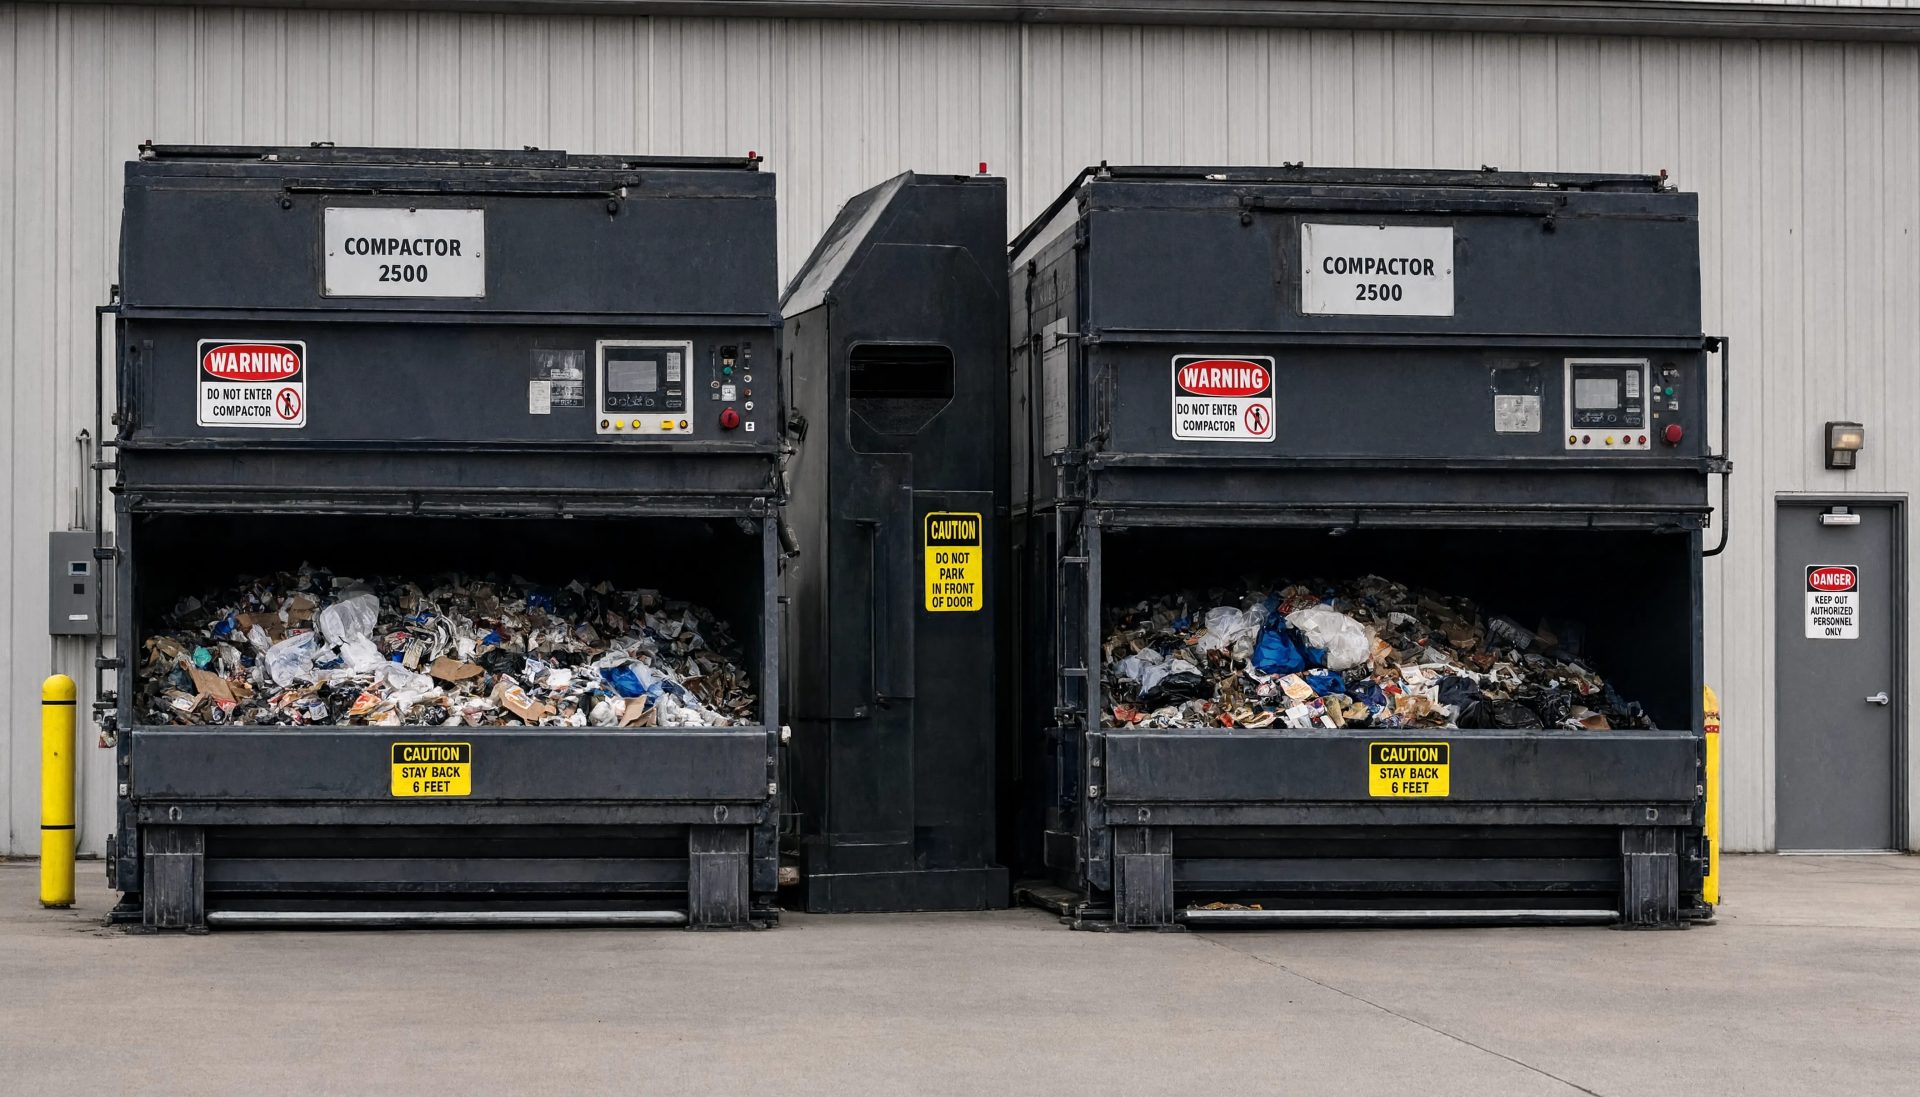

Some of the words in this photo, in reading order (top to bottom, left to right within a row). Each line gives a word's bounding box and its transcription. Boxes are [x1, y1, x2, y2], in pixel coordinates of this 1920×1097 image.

[344, 238, 462, 257] COMPACTOR
[1323, 257, 1435, 276] COMPACTOR
[379, 264, 428, 283] 2500
[1355, 284, 1402, 301] 2500
[210, 352, 295, 373] WARNING
[1183, 368, 1263, 389] WARNING
[207, 388, 220, 400] DO
[223, 388, 241, 400] NOT
[244, 388, 272, 401] ENTER
[213, 405, 272, 417] COMPACTOR
[1177, 403, 1189, 415] DO
[1192, 404, 1210, 415] NOT
[1212, 404, 1238, 416] ENTER
[1183, 420, 1235, 432] COMPACTOR
[931, 520, 976, 540] CAUTION
[936, 553, 948, 564] DO
[951, 553, 970, 564] NOT
[940, 568, 964, 580] PARK
[1813, 573, 1851, 585] DANGER
[932, 583, 941, 594] IN
[945, 583, 975, 594] FRONT
[932, 597, 944, 607] OF
[947, 597, 973, 607] DOOR
[1815, 596, 1832, 604] KEEP
[1835, 596, 1848, 604] OUT
[1811, 607, 1853, 615] AUTHORIZED
[1813, 617, 1852, 625] PERSONNEL
[1825, 628, 1842, 636] ONLY
[403, 747, 460, 761] CAUTION
[1380, 747, 1438, 762] CAUTION
[402, 767, 427, 778] STAY
[432, 767, 461, 778] BACK
[1380, 768, 1406, 779] STAY
[1410, 768, 1439, 779] BACK
[413, 781, 419, 793] 6
[424, 781, 450, 792] FEET
[1392, 782, 1398, 793] 6
[1403, 782, 1429, 793] FEET
